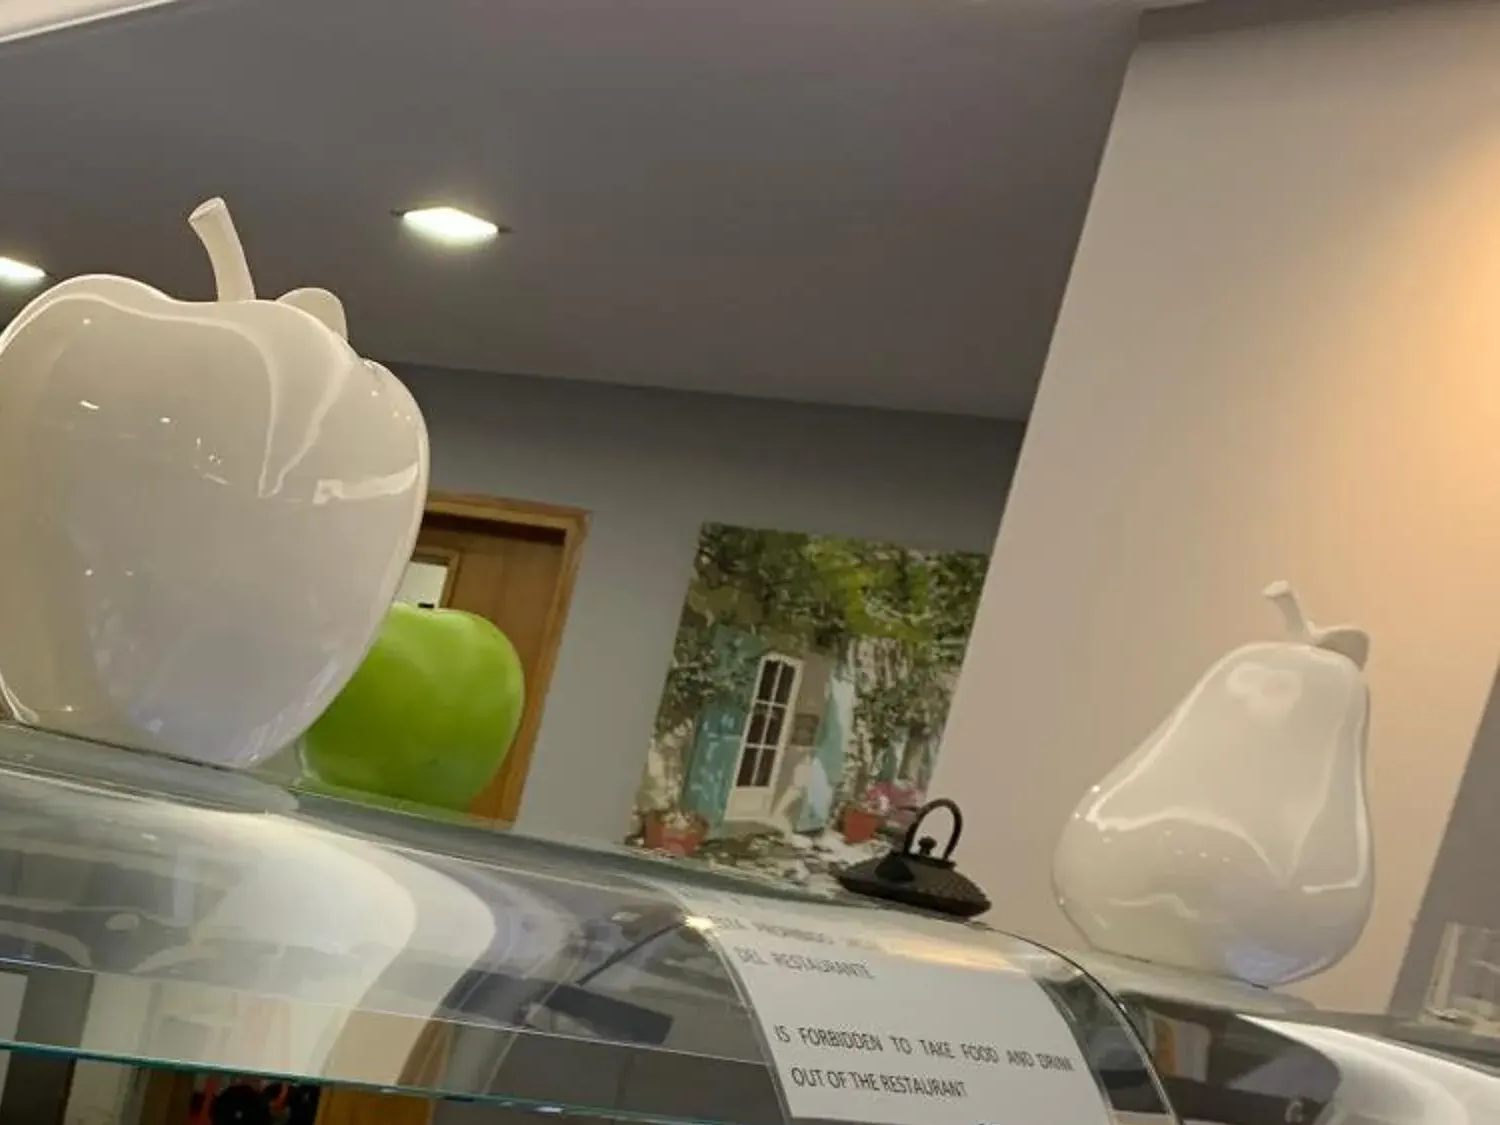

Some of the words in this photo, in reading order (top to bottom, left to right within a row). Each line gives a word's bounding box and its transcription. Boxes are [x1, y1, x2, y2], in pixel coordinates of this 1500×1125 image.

[799, 1027, 884, 1052] FORBIDDEN
[889, 1034, 913, 1056] TO
[918, 1039, 956, 1060] TAKE
[960, 1042, 1000, 1064] FOOD
[1006, 1049, 1035, 1068] AND
[791, 1066, 824, 1087] OUT
[826, 1071, 848, 1089] OF
[848, 1071, 880, 1092] THE
[879, 1073, 968, 1098] RESTAURANT
